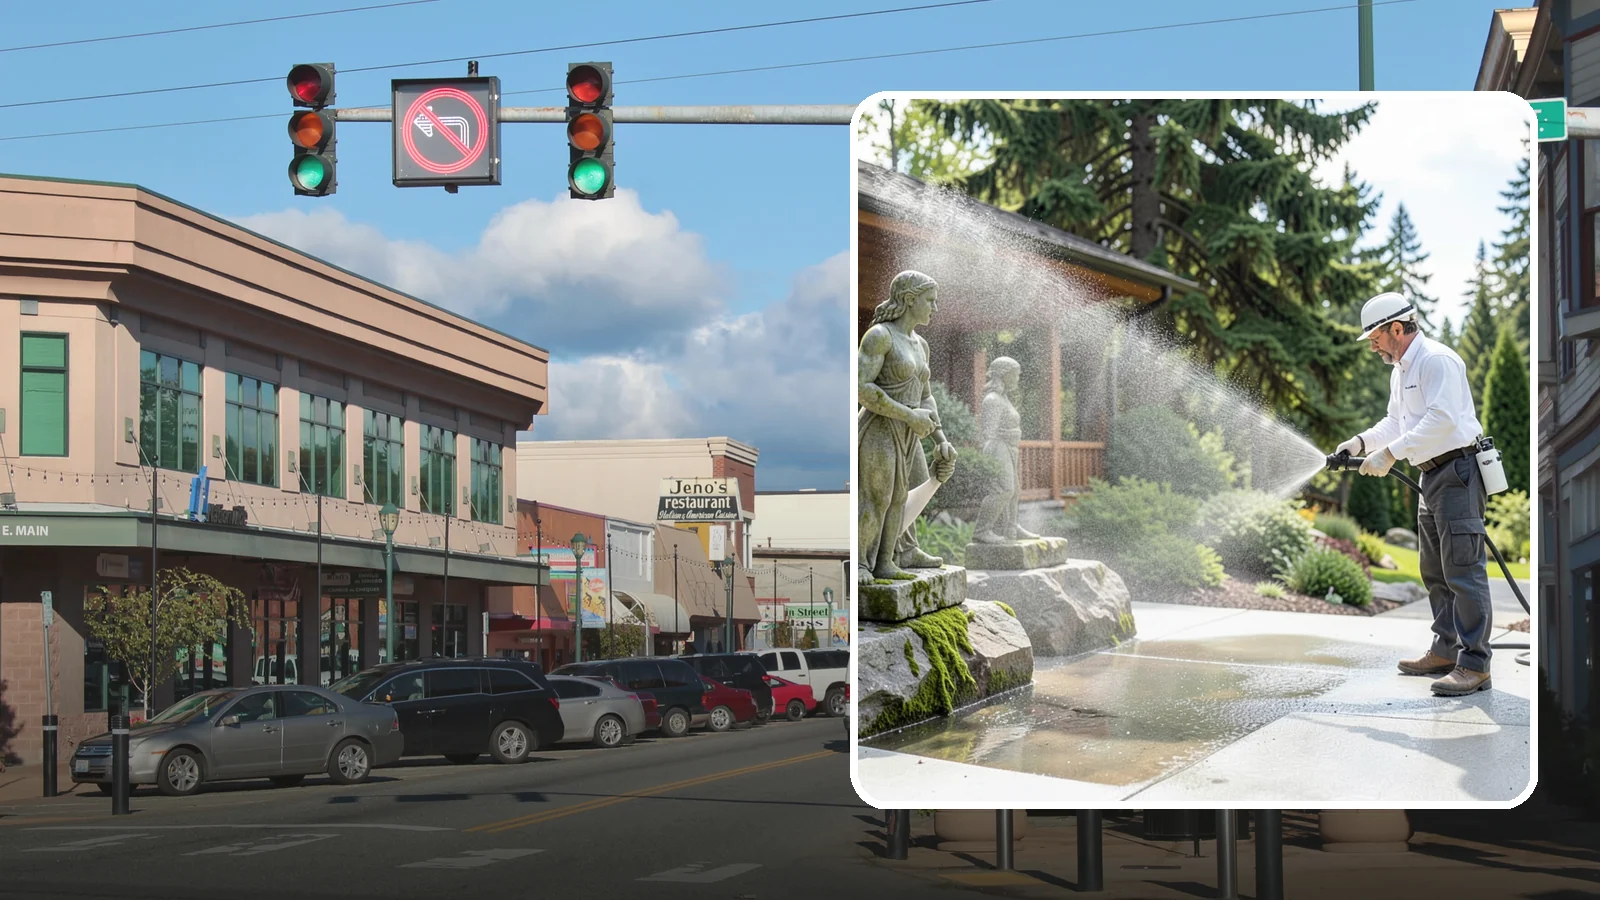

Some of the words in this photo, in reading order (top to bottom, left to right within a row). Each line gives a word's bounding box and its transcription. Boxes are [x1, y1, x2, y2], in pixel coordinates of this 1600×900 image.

[670, 480, 727, 494] Jeno's
[665, 497, 731, 509] restaurant
[687, 510, 714, 519] American
[715, 510, 738, 519] Cuisine
[2, 525, 13, 536] E.
[15, 525, 49, 536] MAIN
[797, 608, 828, 616] Street
